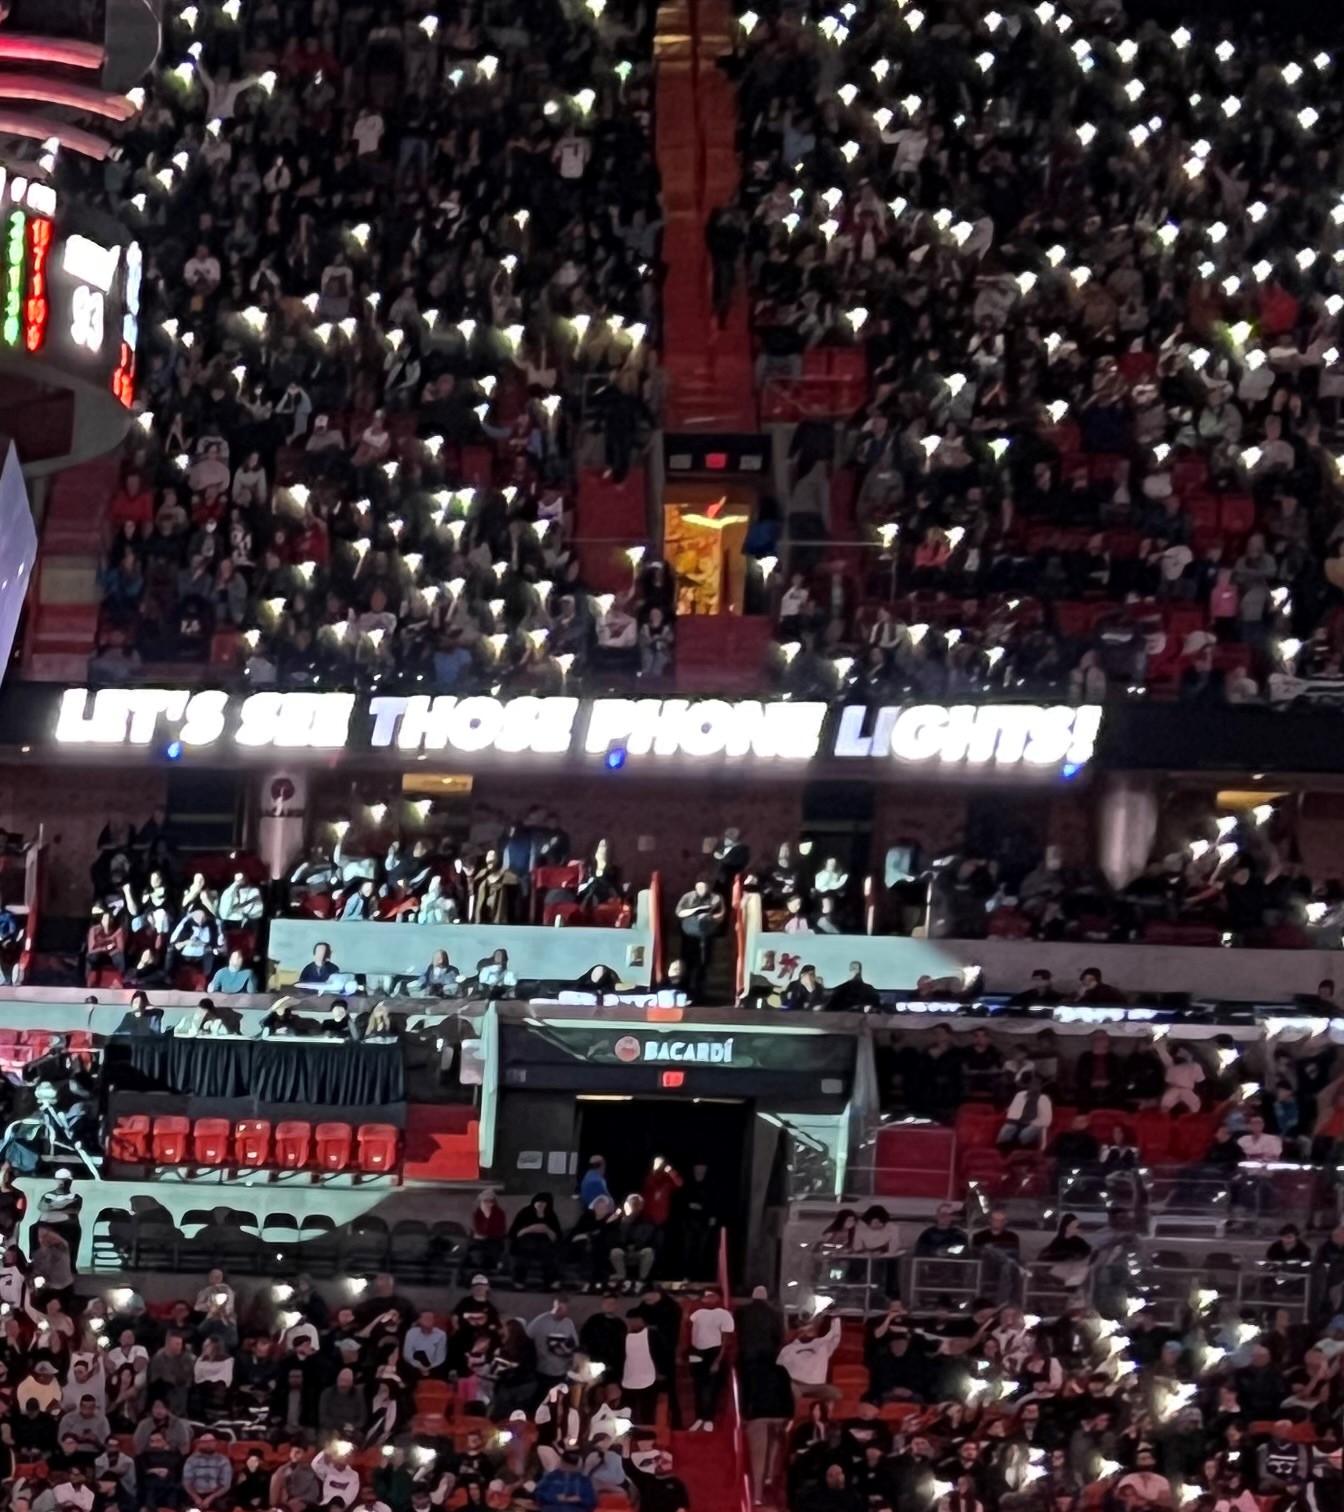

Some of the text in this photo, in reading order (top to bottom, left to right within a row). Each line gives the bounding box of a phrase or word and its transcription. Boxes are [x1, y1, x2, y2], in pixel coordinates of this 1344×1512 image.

[56, 688, 1103, 764] LET'S SEE THOSE PHONE LIGHTS!
[643, 1037, 734, 1063] BACARDÍ
